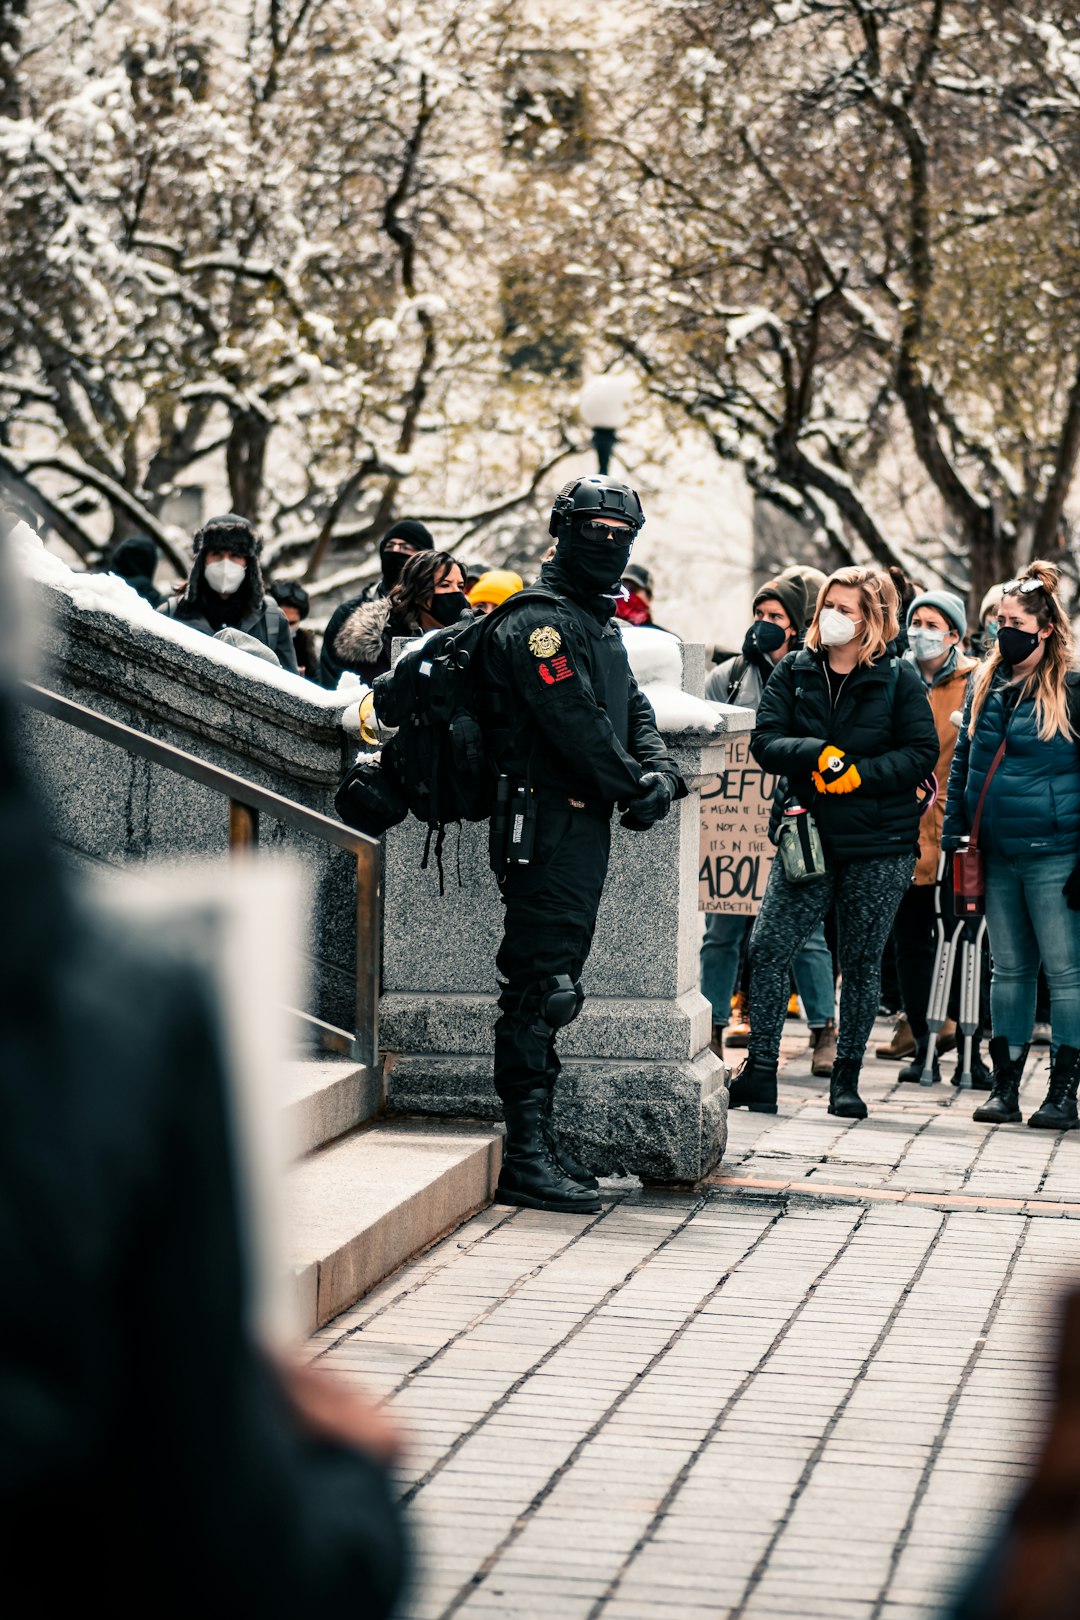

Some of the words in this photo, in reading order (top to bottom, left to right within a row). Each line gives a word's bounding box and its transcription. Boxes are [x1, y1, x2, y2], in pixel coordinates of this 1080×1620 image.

[711, 804, 738, 814] MEAN
[716, 823, 735, 832] NOT
[739, 824, 748, 832] A
[710, 840, 726, 852] ITS
[749, 841, 767, 853] THE
[699, 854, 774, 901] ABOL
